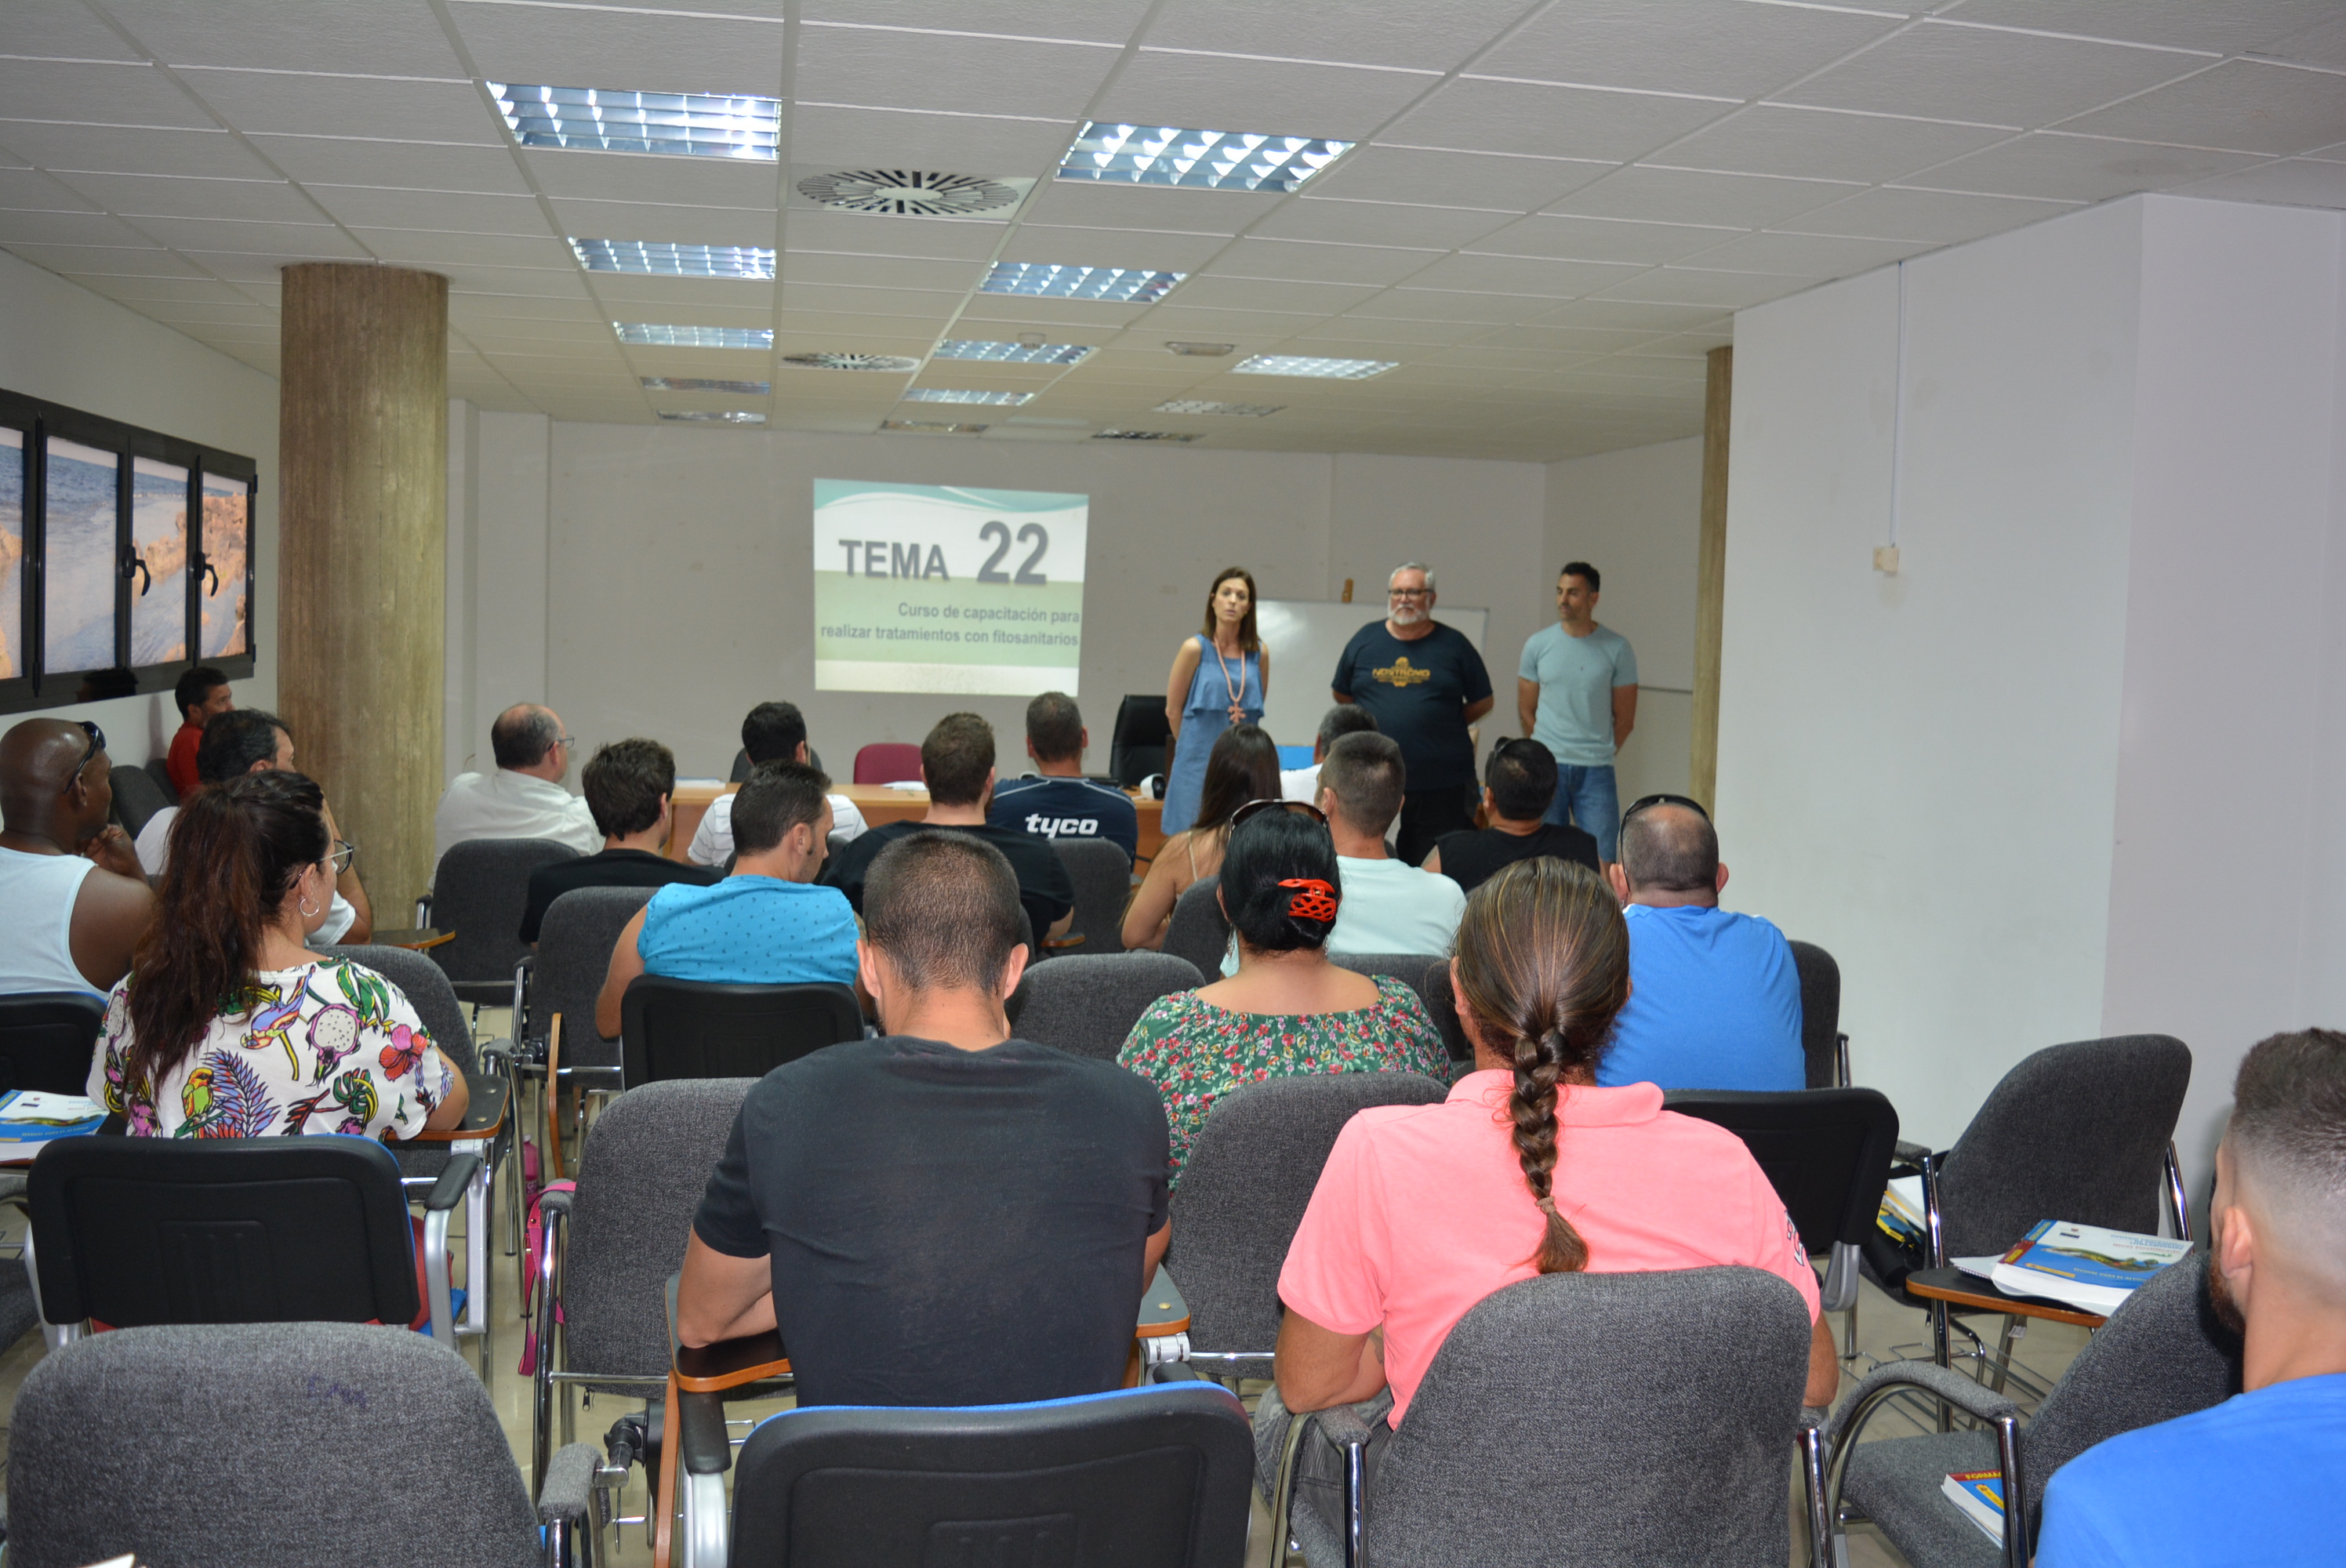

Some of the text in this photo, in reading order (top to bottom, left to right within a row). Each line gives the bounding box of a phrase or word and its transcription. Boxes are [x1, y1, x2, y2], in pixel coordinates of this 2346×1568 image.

[838, 521, 1048, 586] TEMA 22
[899, 602, 1080, 624] Curso de capacitación para
[821, 624, 1078, 645] realizar tratamientos con fitosanitarios
[1371, 668, 1431, 677] NOSTROMO
[1025, 812, 1099, 839] tyco
